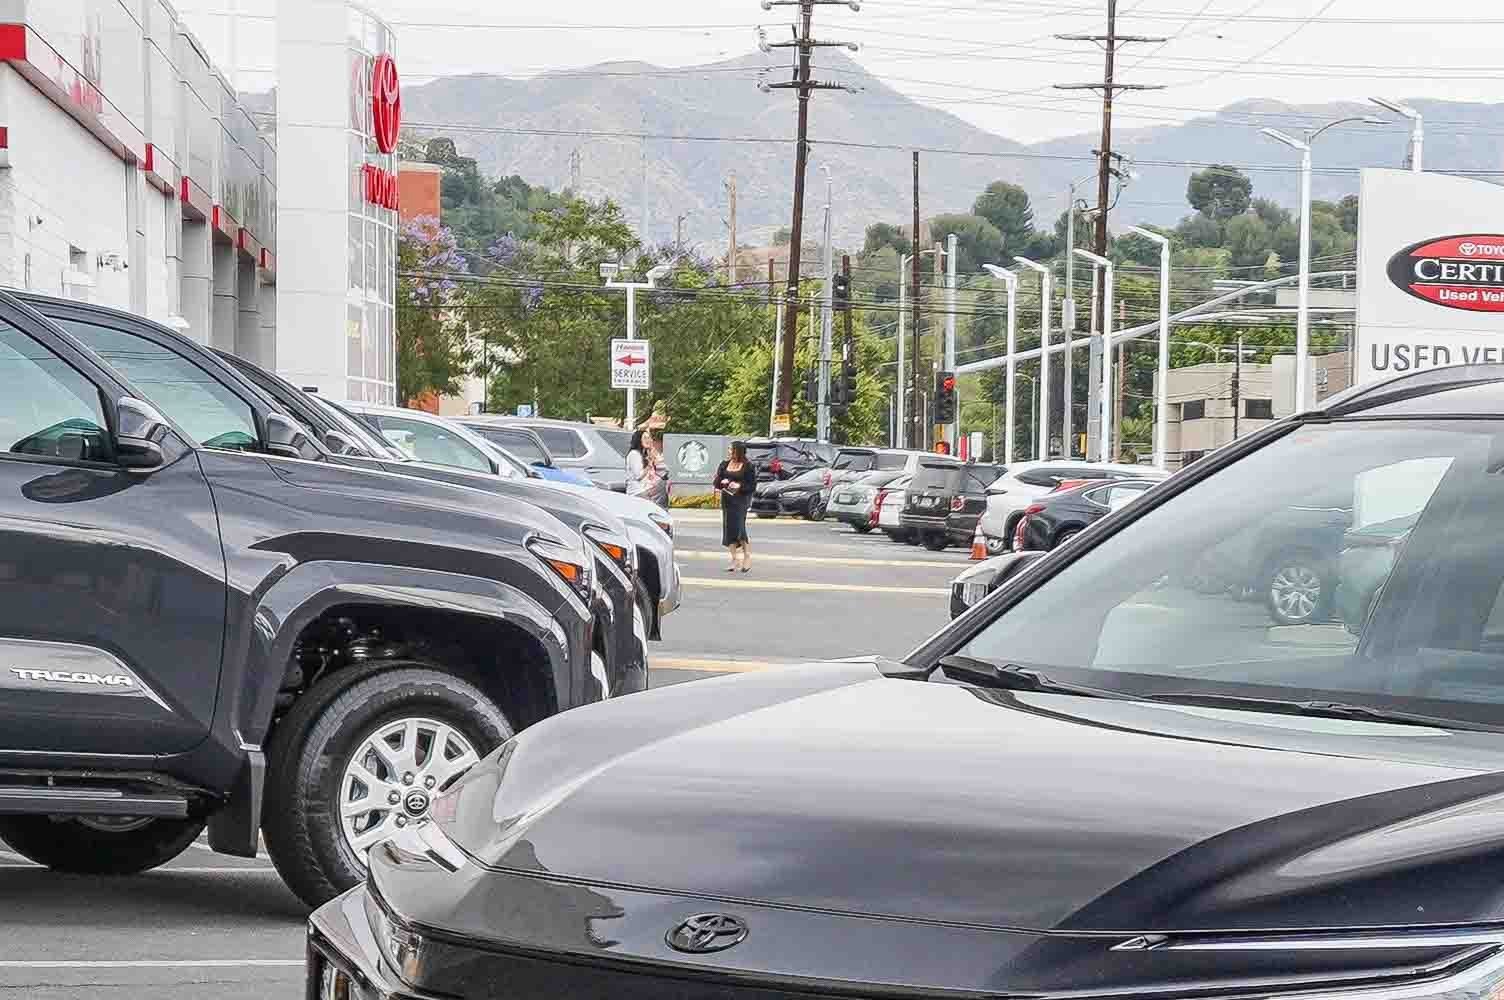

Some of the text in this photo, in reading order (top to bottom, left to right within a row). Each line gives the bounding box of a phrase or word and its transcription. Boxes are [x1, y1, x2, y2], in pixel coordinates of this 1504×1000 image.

[1439, 290, 1477, 302] Used
[1371, 344, 1450, 371] USED
[613, 368, 647, 378] SERVICE
[9, 665, 133, 687] TACOMA
